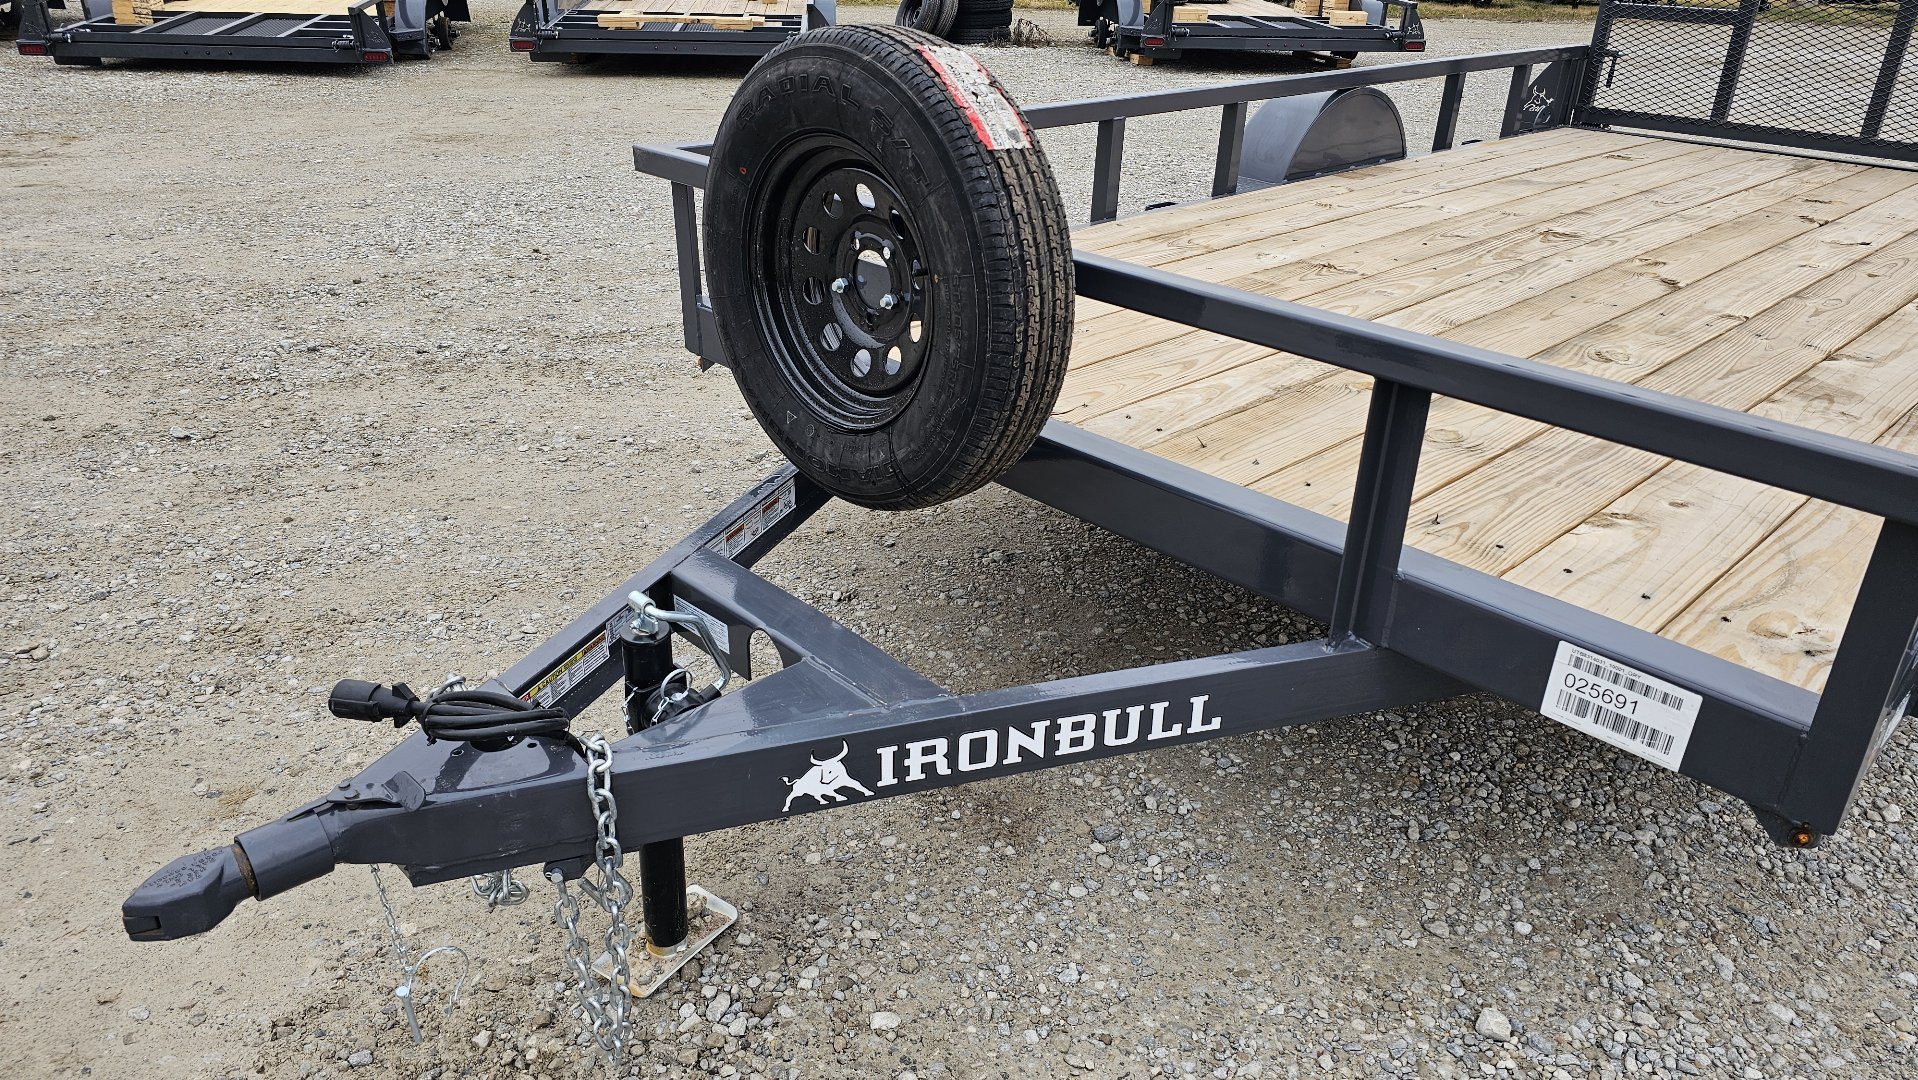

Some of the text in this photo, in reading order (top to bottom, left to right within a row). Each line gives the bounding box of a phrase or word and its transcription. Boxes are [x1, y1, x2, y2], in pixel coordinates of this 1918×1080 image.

[735, 74, 861, 129] RADIAL
[1564, 673, 1639, 715] 025691
[876, 694, 1222, 788] IRONBULL
